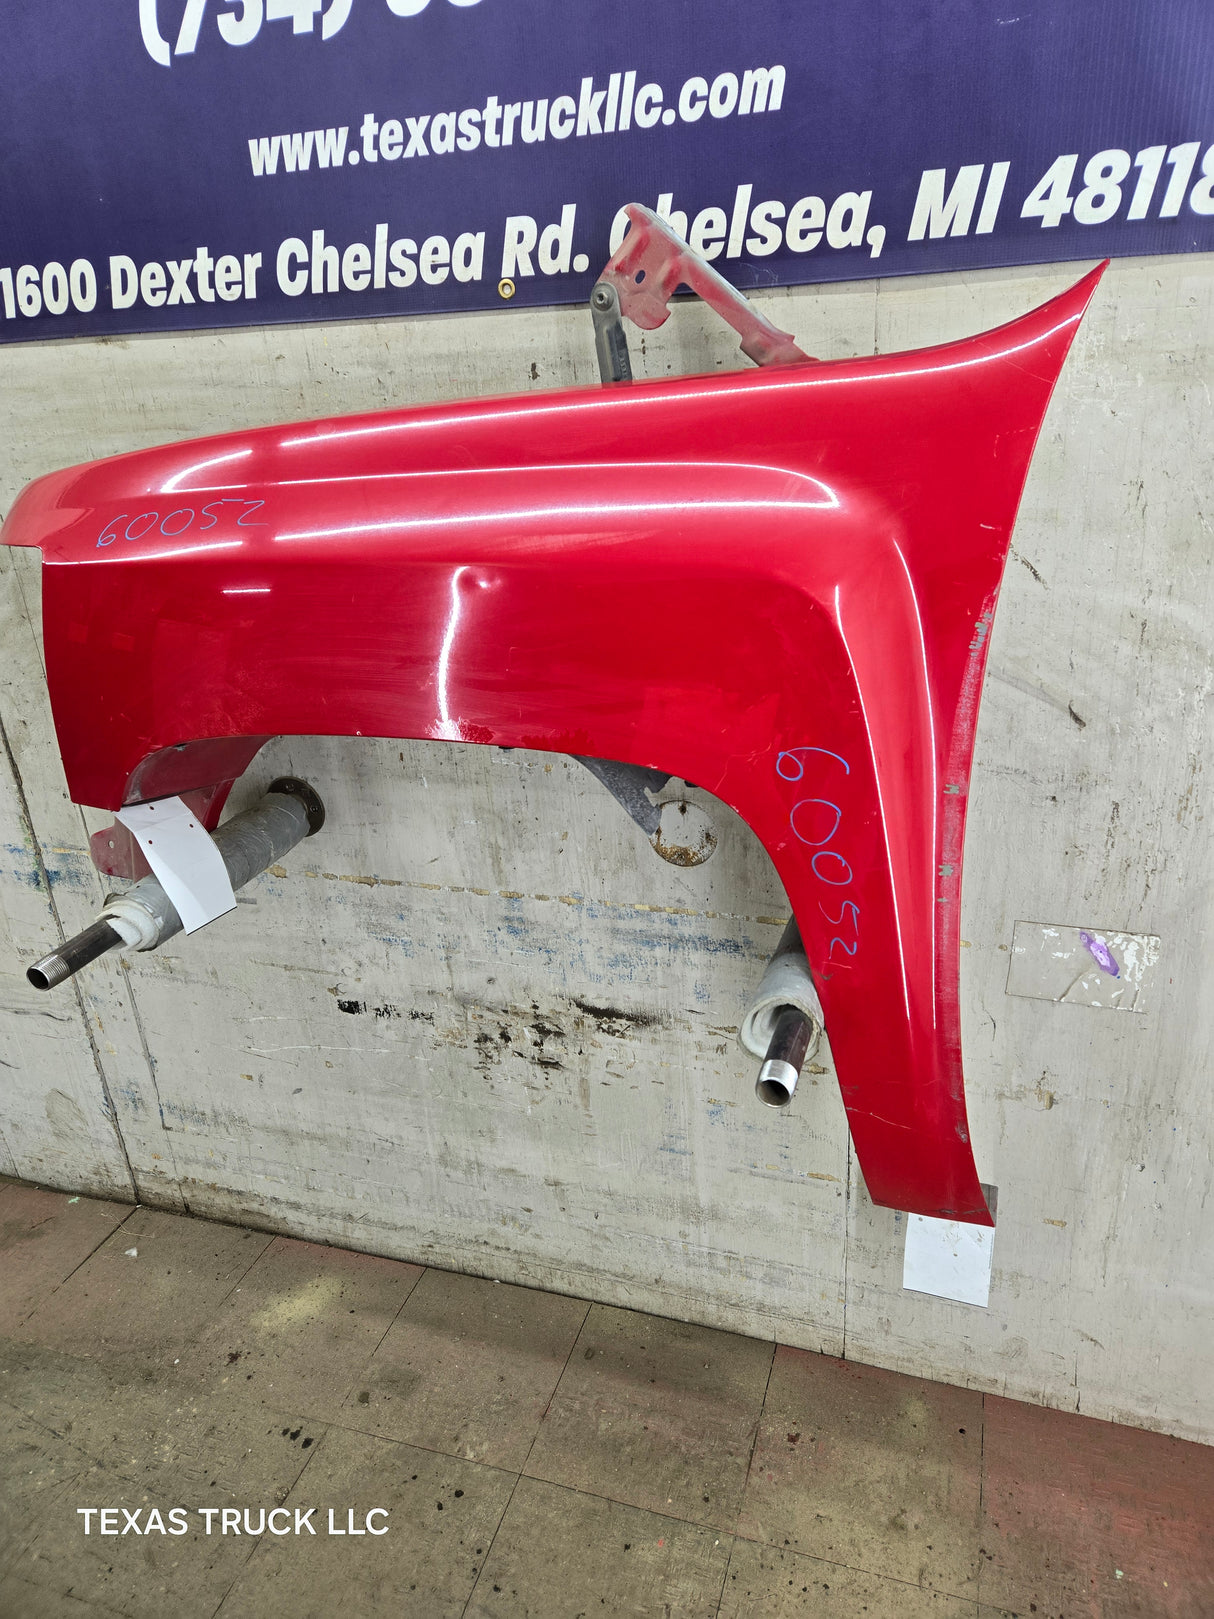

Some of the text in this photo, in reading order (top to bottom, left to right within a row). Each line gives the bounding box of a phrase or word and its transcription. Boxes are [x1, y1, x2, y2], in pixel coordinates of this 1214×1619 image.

[248, 64, 787, 177] www.texastruckllc.com
[109, 246, 262, 310] Dexter
[276, 223, 486, 297] Chelsea
[502, 203, 590, 279] Rd.
[907, 161, 1011, 242] MI
[96, 498, 268, 548] 60052
[776, 746, 860, 960] 60052
